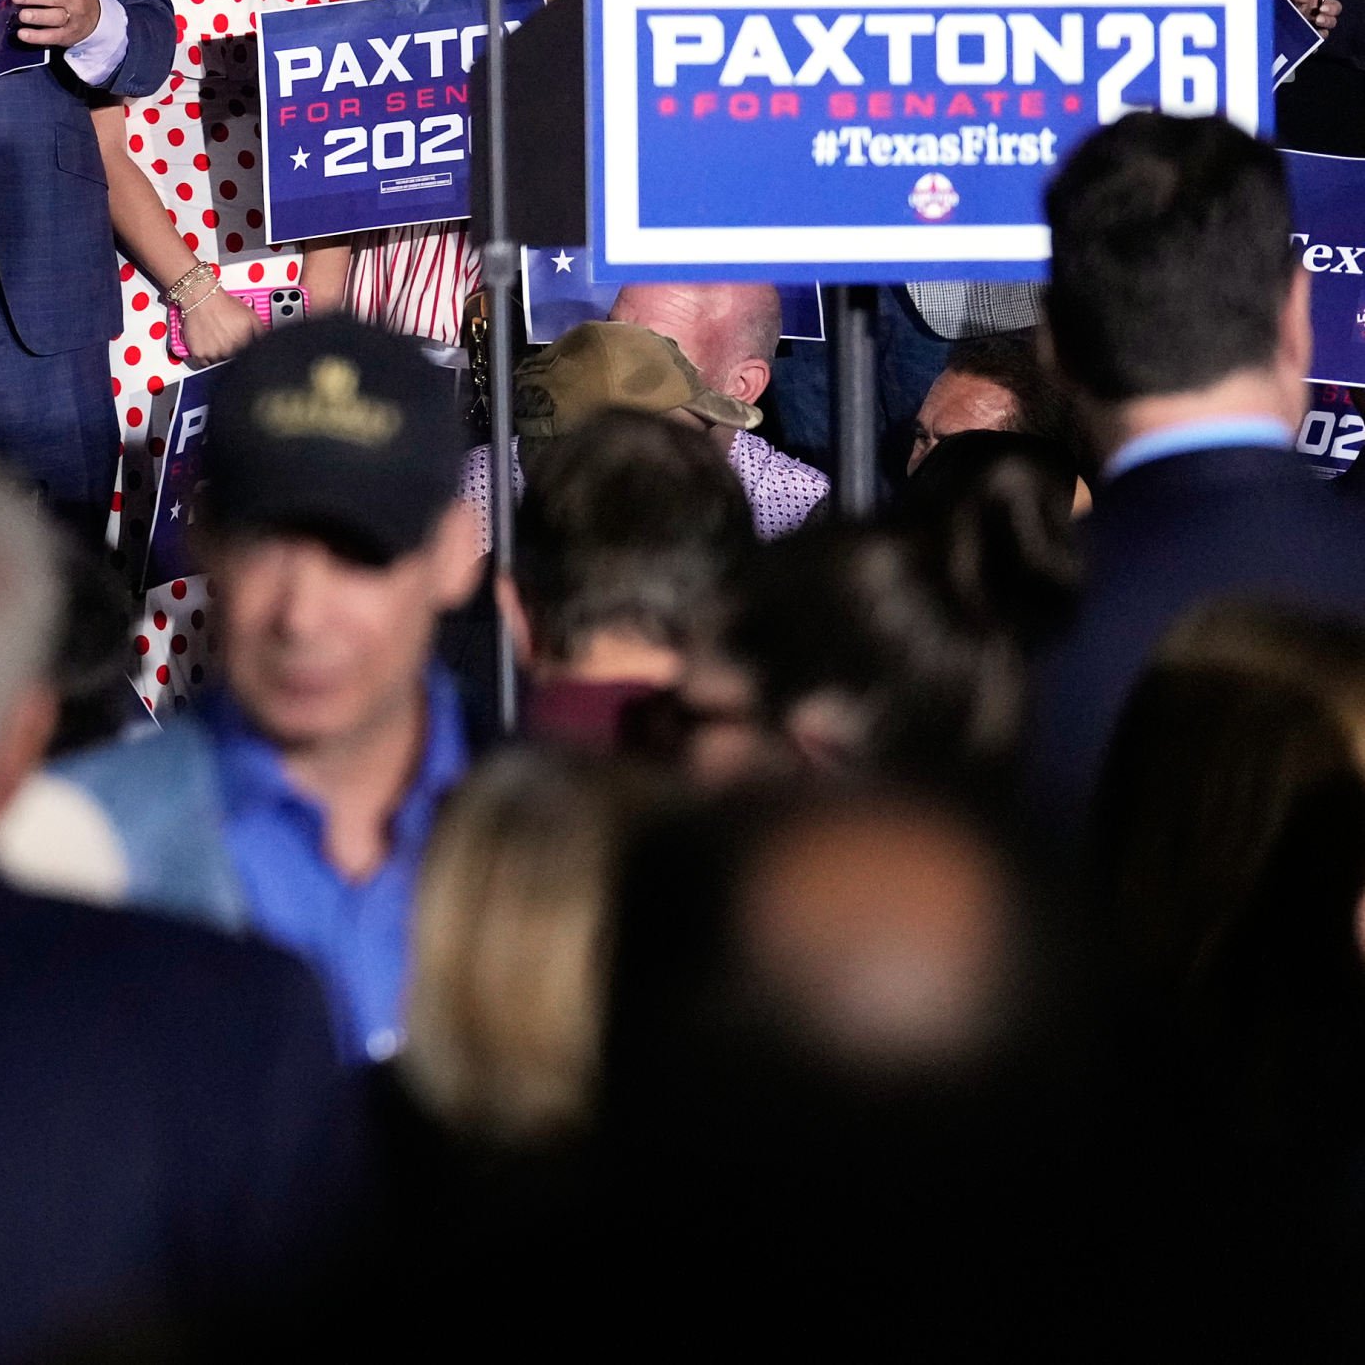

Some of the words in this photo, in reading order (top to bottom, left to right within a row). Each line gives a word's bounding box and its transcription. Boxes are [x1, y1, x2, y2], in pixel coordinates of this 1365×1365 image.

[646, 12, 1085, 87] PAXTON
[1095, 12, 1219, 124] 26
[279, 98, 361, 127] FOR
[386, 84, 469, 113] SEN
[692, 92, 802, 119] FOR
[829, 92, 1047, 119] SENATE
[324, 113, 472, 178] 202
[811, 123, 1057, 167] #TexasFirst
